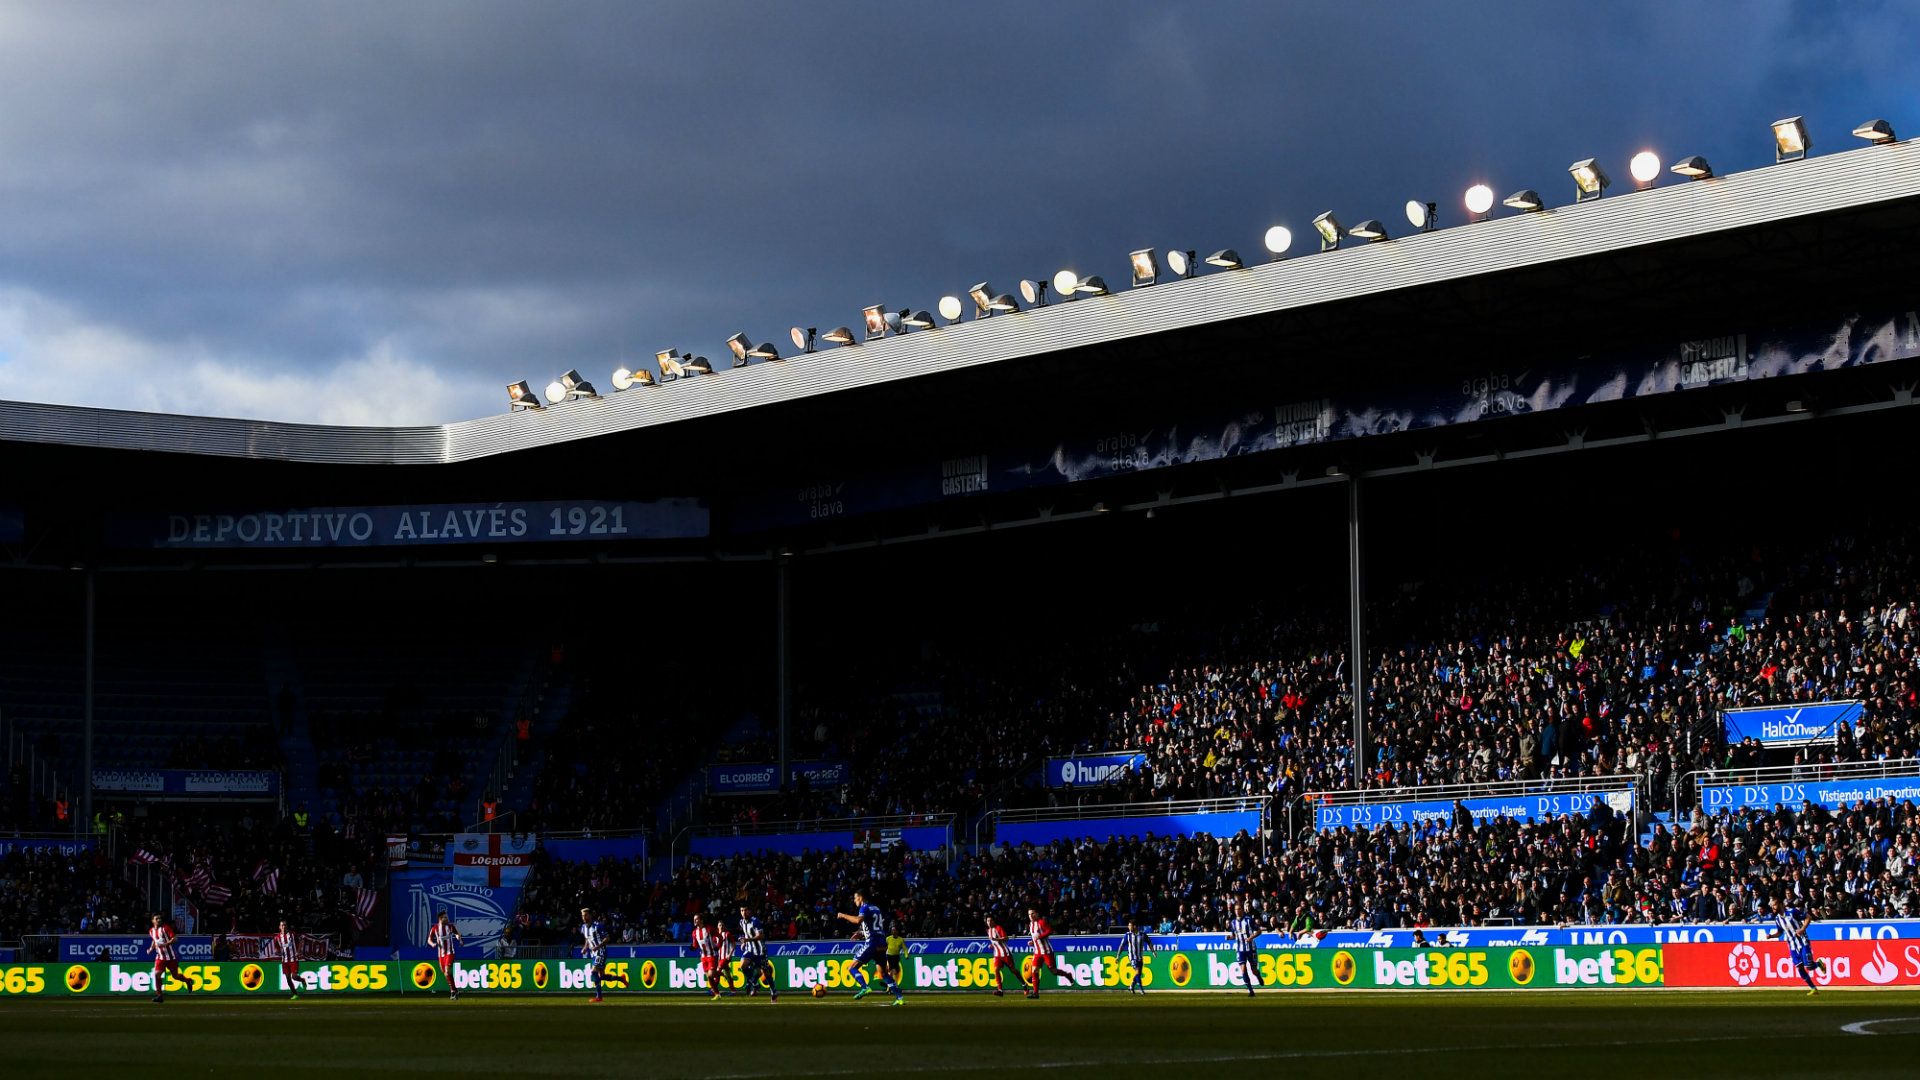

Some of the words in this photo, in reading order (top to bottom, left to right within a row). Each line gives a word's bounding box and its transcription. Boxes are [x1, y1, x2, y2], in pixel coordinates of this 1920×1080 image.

[1462, 371, 1509, 396] araba
[1274, 400, 1321, 424] VITORIA
[1096, 431, 1137, 454] araba
[942, 456, 980, 477] VITORIA
[798, 482, 832, 502] araba
[167, 512, 374, 543] DEPORTIVO
[394, 502, 528, 539] ALAVÉS
[550, 505, 628, 535] 1921
[720, 774, 732, 784] EL
[732, 772, 771, 783] CORREO
[1818, 788, 1863, 802] Vistiendo
[1865, 787, 1874, 801] al
[1412, 809, 1450, 822] Vistiendo
[1501, 804, 1528, 817] Alavés
[470, 854, 521, 866] LOGROÑO
[69, 944, 85, 955] EL
[86, 944, 139, 955] CORREO
[452, 962, 524, 989] bet365
[559, 961, 630, 989] bet65
[1373, 950, 1489, 986] bet365
[1553, 948, 1664, 984] bet36
[0, 967, 45, 994] 65
